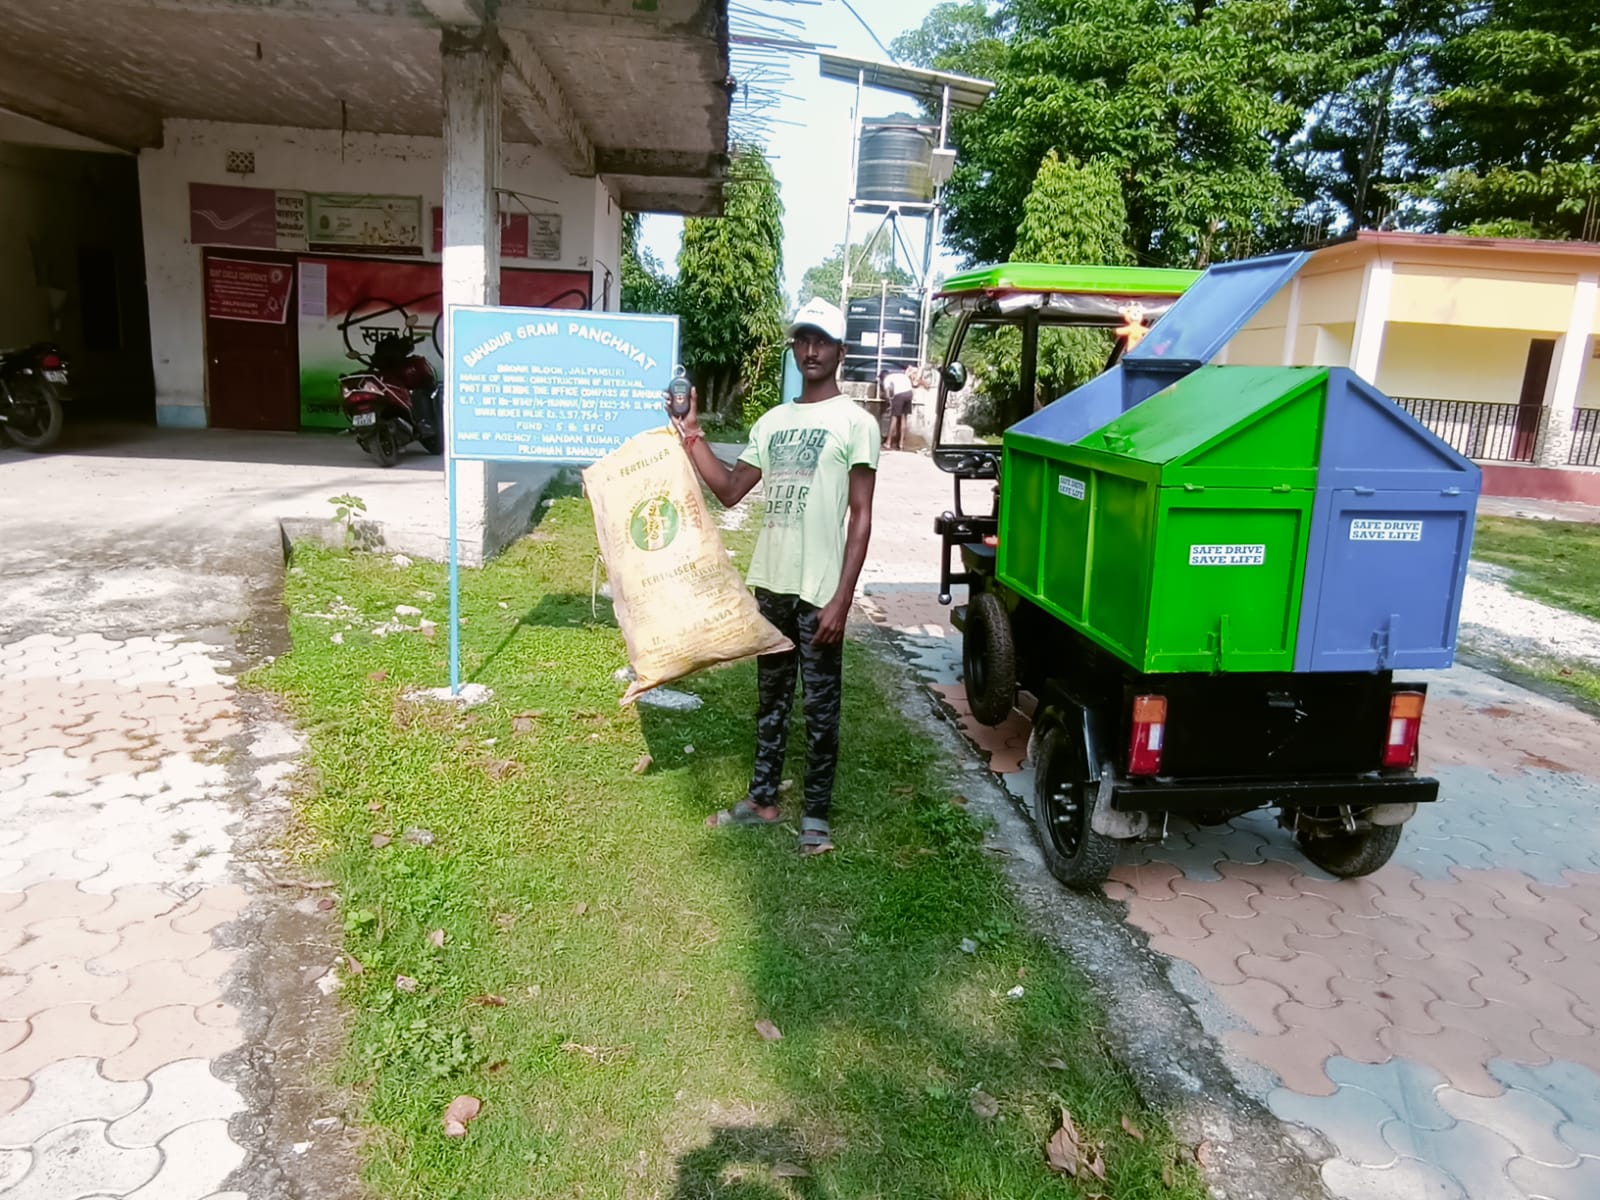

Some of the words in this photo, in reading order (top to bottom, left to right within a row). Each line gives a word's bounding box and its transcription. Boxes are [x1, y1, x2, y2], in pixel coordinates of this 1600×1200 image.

[463, 331, 514, 368] BAHADUR
[516, 321, 559, 340] GRAM
[568, 322, 657, 371] PANCHAYAT
[619, 448, 671, 478] FERTILISER
[1353, 520, 1382, 530] SAFE
[1383, 521, 1420, 531] DRIVE
[1352, 530, 1386, 539] SAVE
[1388, 531, 1420, 541] LIFE
[1192, 546, 1222, 554] SAFE
[1225, 545, 1263, 554] DRIVE
[1191, 556, 1226, 564] SAVE
[1230, 555, 1262, 564] LIFE
